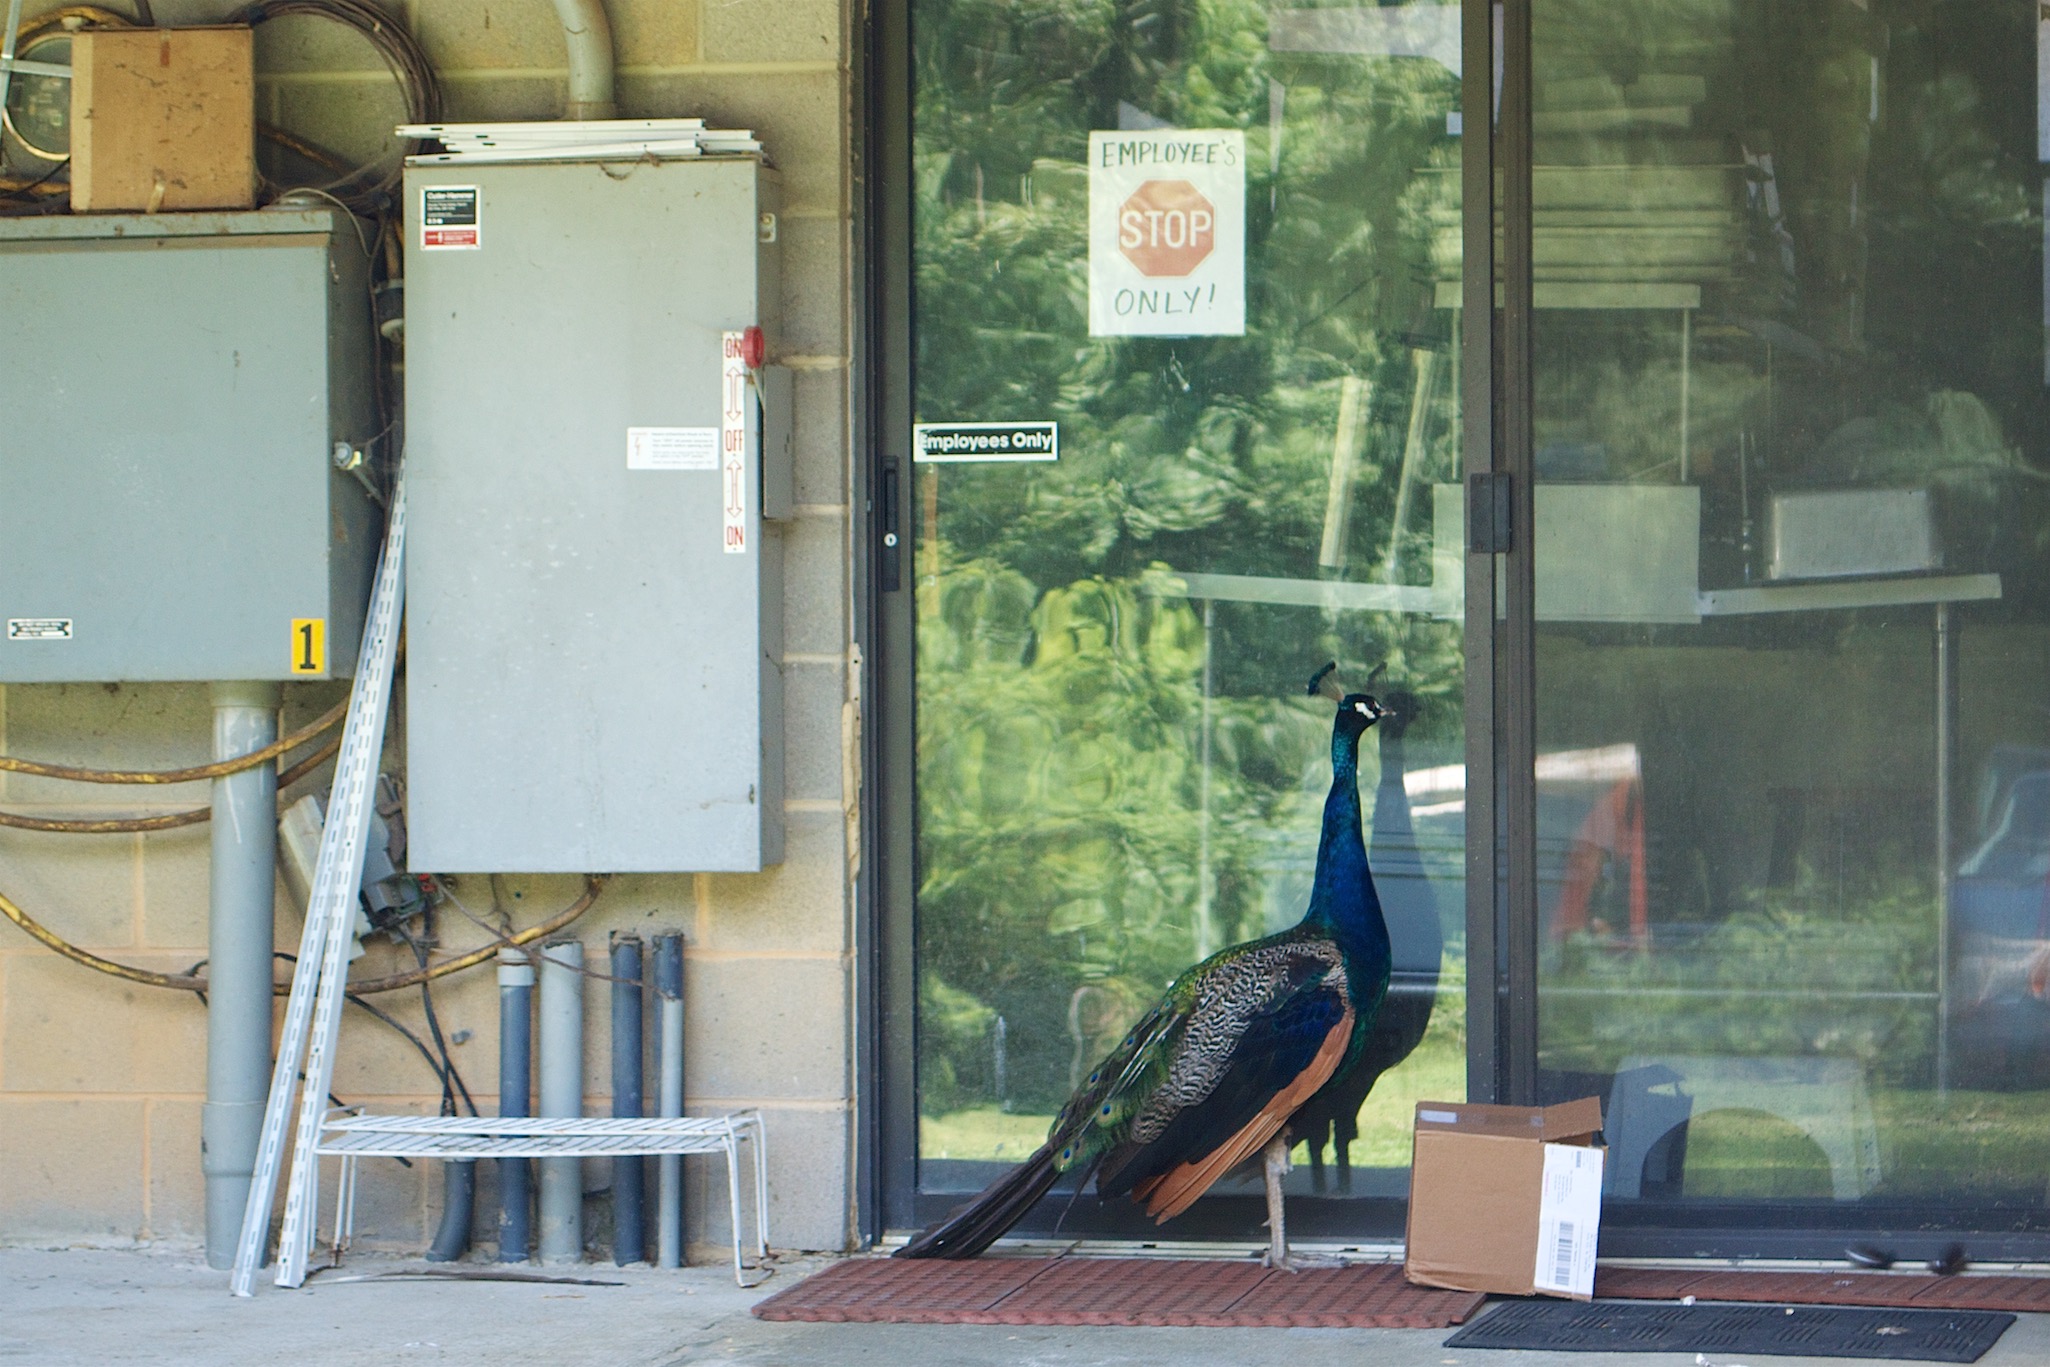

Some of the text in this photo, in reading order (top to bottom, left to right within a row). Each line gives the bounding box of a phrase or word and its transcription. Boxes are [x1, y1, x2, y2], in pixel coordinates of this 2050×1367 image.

[1102, 138, 1236, 168] EMPLOYEE'S
[1120, 210, 1212, 248] STOP
[1115, 283, 1216, 315] ONLY!
[725, 338, 742, 358] ON
[725, 429, 743, 451] OFF
[919, 431, 1053, 452] Employees Only
[726, 525, 744, 546] ON
[300, 623, 316, 669] 1
